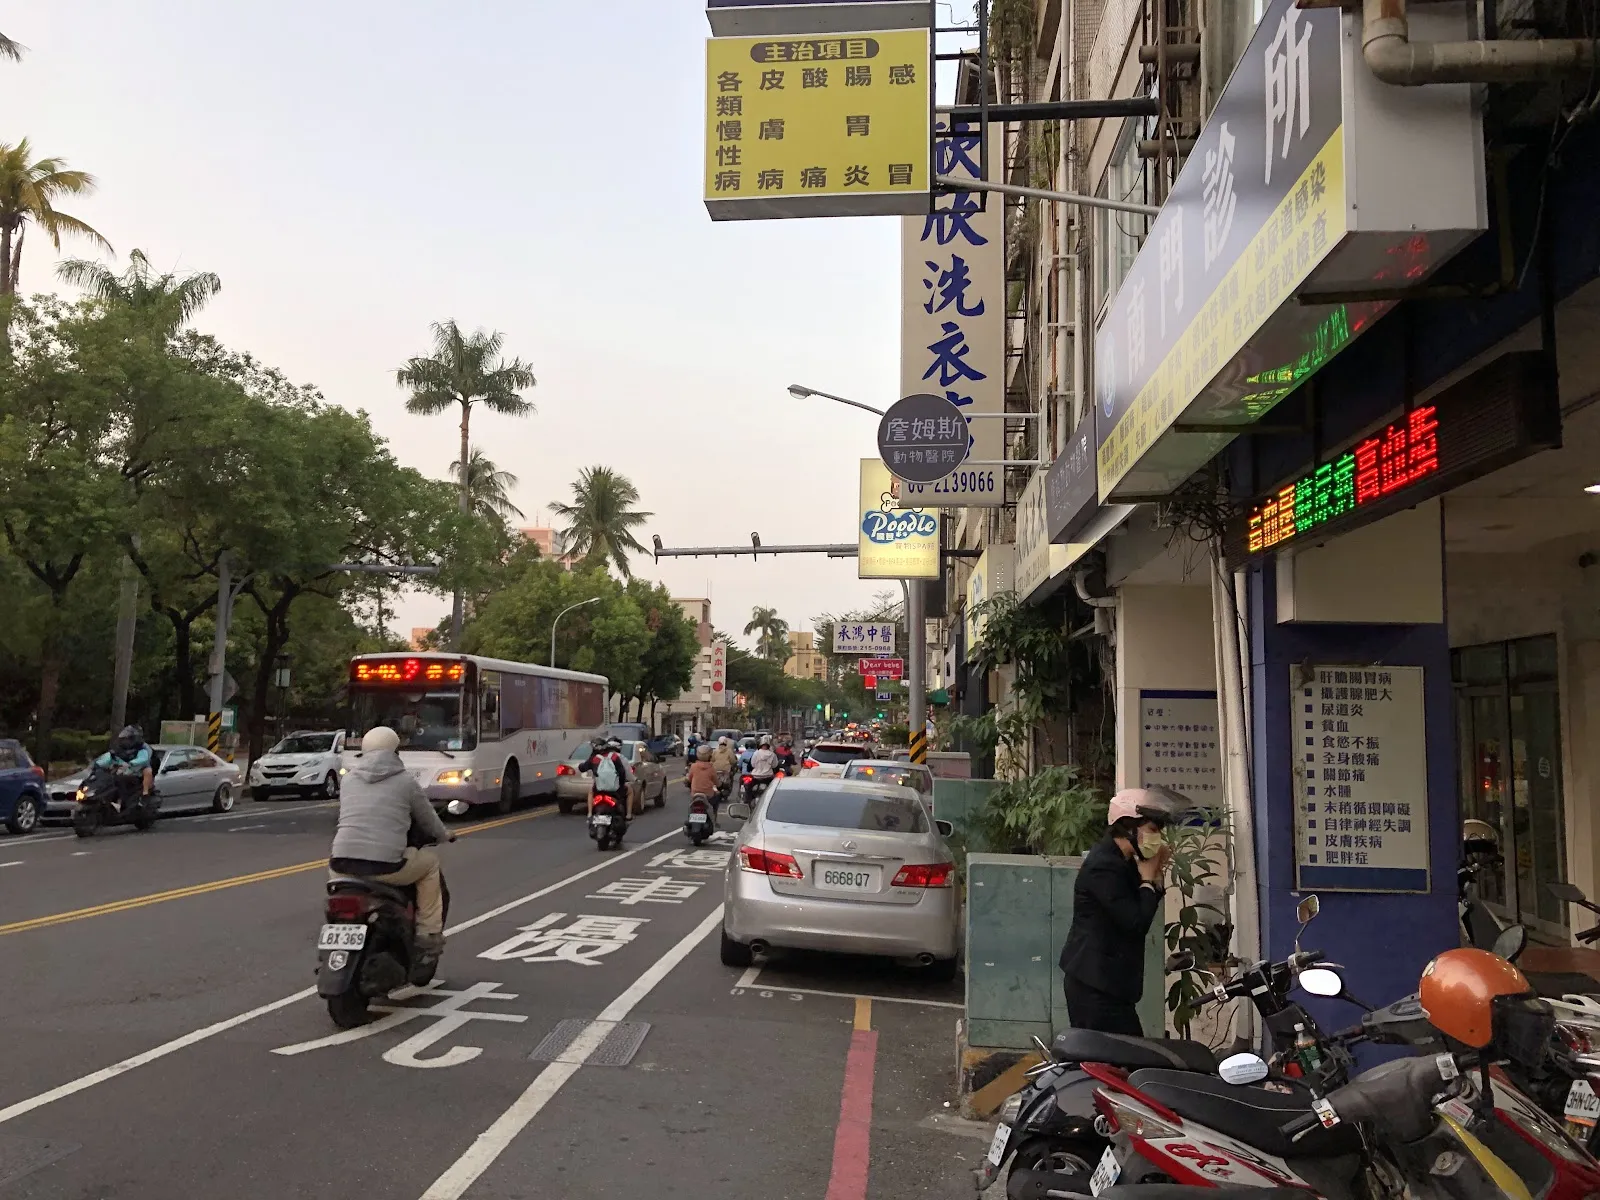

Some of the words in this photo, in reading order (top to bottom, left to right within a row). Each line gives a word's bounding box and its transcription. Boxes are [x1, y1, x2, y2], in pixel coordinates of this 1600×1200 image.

[764, 39, 870, 61] 主治項目
[714, 71, 743, 192] 各類慢性病
[757, 69, 785, 190] 皮膚病
[800, 68, 828, 188] 酸痛
[843, 66, 872, 186] 腸胃炎
[888, 64, 915, 186] 感冒
[1127, 4, 1313, 386] 南門診所
[886, 416, 963, 442] 詹姆斯
[893, 450, 955, 464] 動物醫院
[868, 513, 935, 537] Poodle
[714, 647, 724, 677] 六本木
[862, 660, 881, 669] Dear
[1320, 671, 1392, 685] 肝膽腸胃病
[1321, 687, 1392, 701] 攝護腺肥大
[1321, 703, 1363, 716] 尿道炎
[1322, 719, 1349, 732] 貧血
[1322, 735, 1380, 749] 食慾不振
[1323, 752, 1380, 766] 全身酸痛
[1323, 768, 1365, 781] 關節痛
[1324, 785, 1352, 798] 水腫
[1324, 818, 1411, 833] 自律神經失調
[1325, 835, 1382, 848] 皮膚疾病
[1326, 851, 1368, 865] 肥胖症
